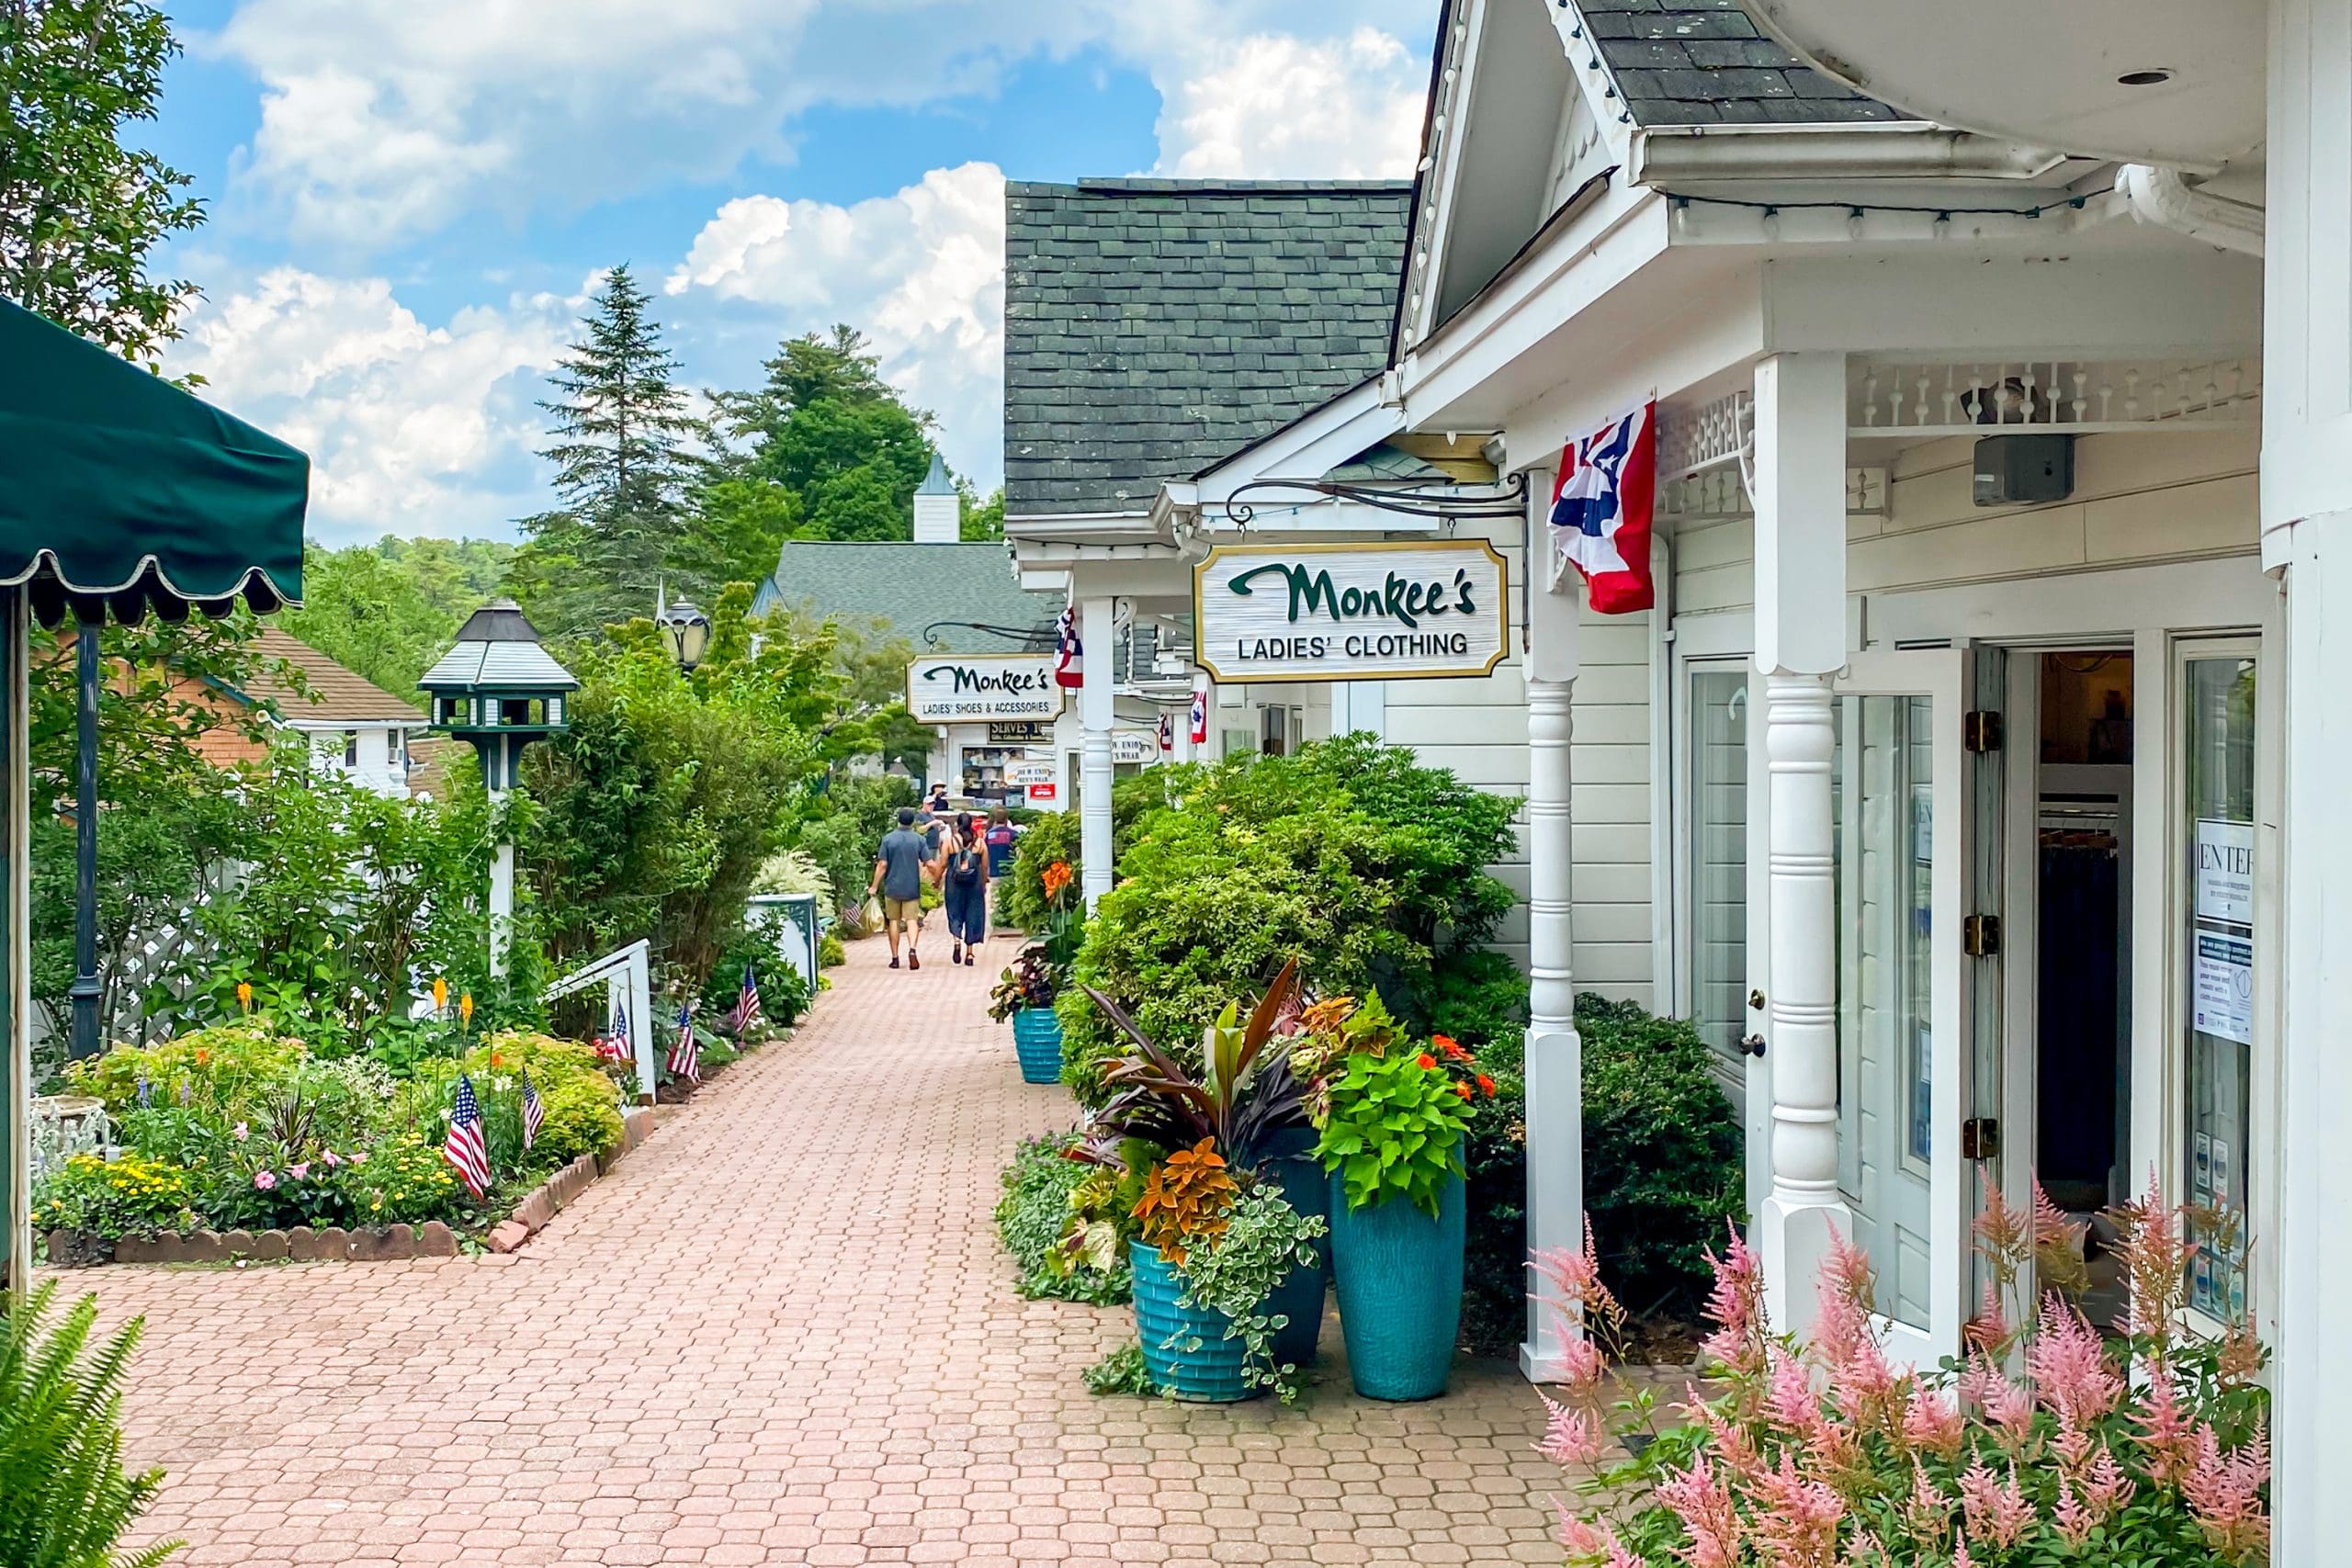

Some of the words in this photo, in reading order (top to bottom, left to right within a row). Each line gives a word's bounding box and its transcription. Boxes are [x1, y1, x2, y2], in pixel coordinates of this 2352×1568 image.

[1227, 563, 1476, 628] Monkee's
[1238, 637, 1332, 660] LADIES'
[1345, 633, 1468, 657] CLOTHING
[922, 665, 1049, 696] Monkee's
[922, 704, 954, 715] LADIES'
[956, 703, 982, 714] SHOES
[986, 703, 991, 713] &
[995, 702, 1049, 713] ACCESSORIES
[991, 722, 1028, 734] SERVES
[1121, 751, 1140, 761] WEAR
